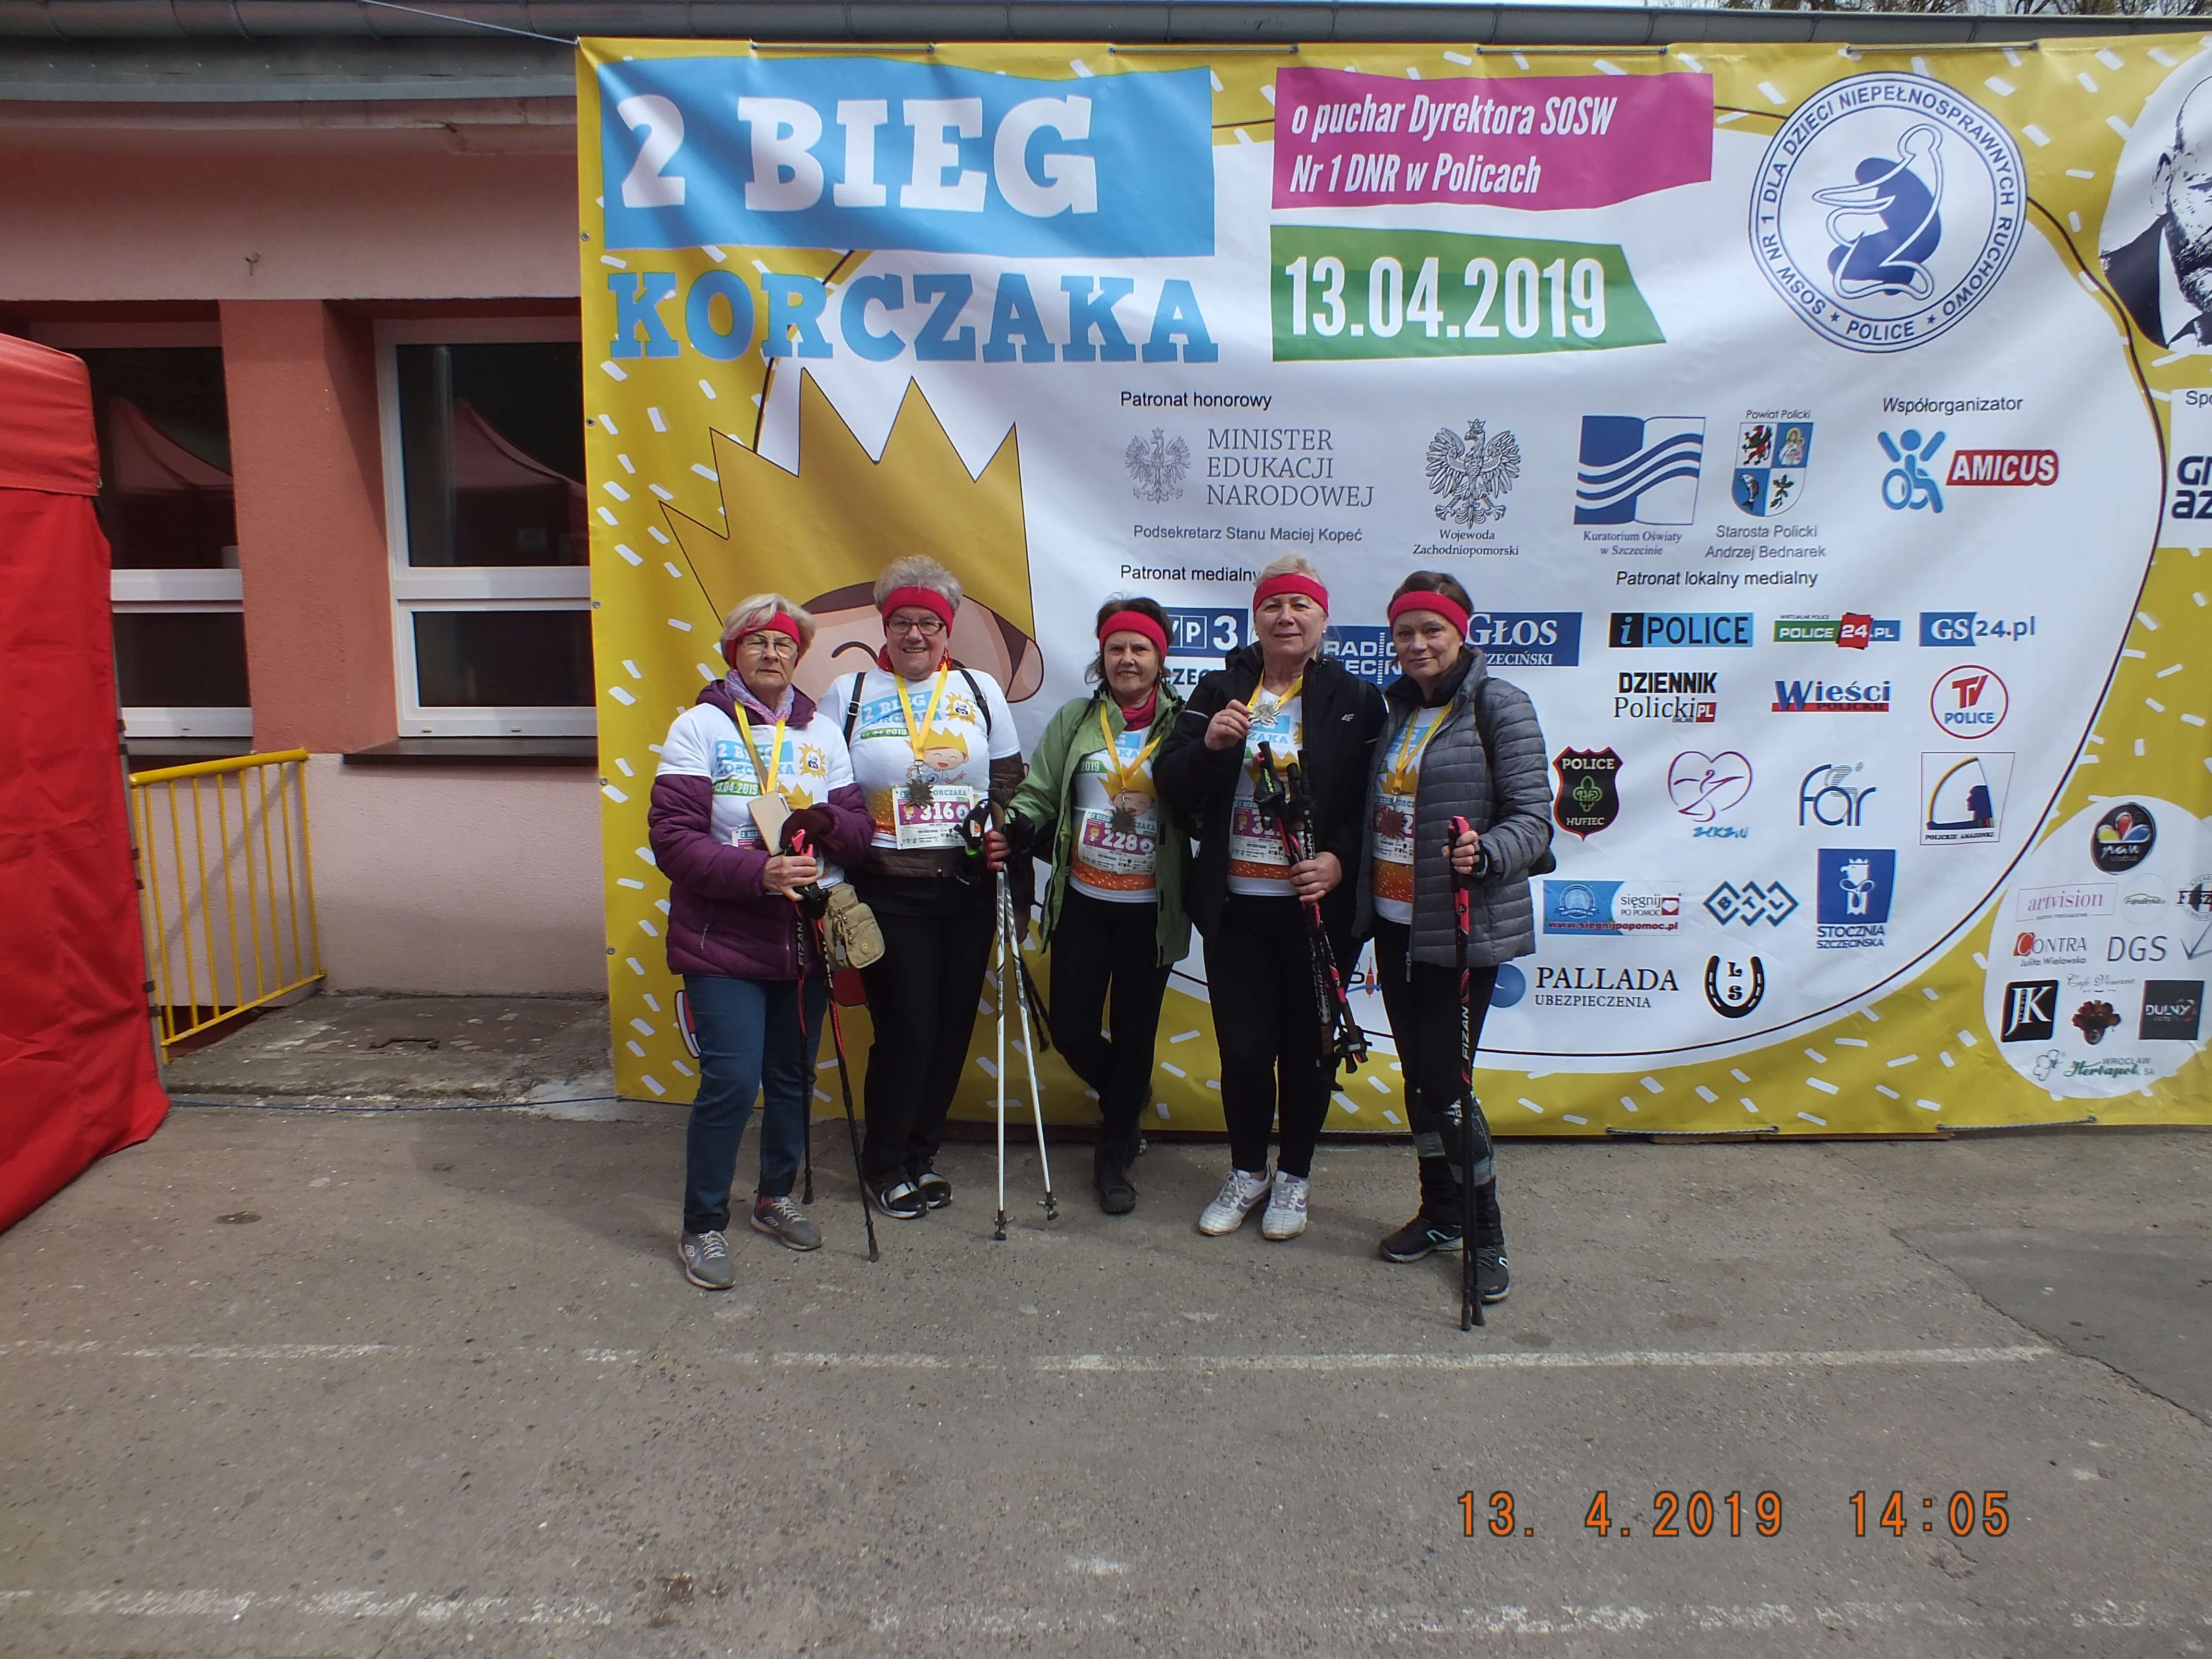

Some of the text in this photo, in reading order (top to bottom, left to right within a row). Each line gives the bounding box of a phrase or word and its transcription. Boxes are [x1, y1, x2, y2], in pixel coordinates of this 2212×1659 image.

[1291, 94, 1618, 142] o puchar Dyrektora SOSW
[618, 95, 1097, 218] 2 BIEG
[1290, 153, 1541, 193] Nr 1 DNR w Policach
[1762, 85, 2015, 316] SOSW NR 1 DLA DZIECI NIEPEŁNOSPRAWNYCH RUCHOWO
[1286, 256, 1606, 339] 13.04.2019
[609, 270, 1219, 363] KORCZAKA
[1846, 321, 1915, 341] POLICE
[1121, 392, 1272, 410] Patronat honorowy
[1883, 397, 2023, 415] Współorganizator
[1746, 410, 1811, 419] Powiat Policki
[1208, 429, 1333, 450] MINISTER
[1207, 457, 1334, 479] EDUKACJI
[1953, 456, 2055, 481] AMICUS
[1207, 485, 1374, 507] NARODOWEJ
[1134, 526, 1362, 543] Podsekretarz Stanu Maciej Kopeć
[1440, 530, 1494, 542] Wojewoda
[1584, 531, 1682, 543] Kuratorium Oświaty
[1716, 525, 1817, 538] Starosta Policki
[1413, 545, 1518, 557] Zachodniopomorski
[1611, 546, 1662, 555] Szczecinie
[1706, 545, 1826, 560] Andrzej Bednarek
[1121, 565, 1186, 580] Patronat
[1617, 571, 1818, 589] Patronat lokalny medialny
[1466, 613, 1558, 647] GŁOS
[1485, 651, 1552, 665] ZECIŃSKI
[1619, 672, 1718, 693] DZIENNIK
[1952, 674, 1988, 709] TV
[1775, 681, 1890, 710] Wieści
[1614, 696, 1695, 718] Policki
[1341, 713, 1355, 722] 4F
[1945, 712, 1994, 724] POLICE
[718, 744, 727, 757] 2
[1562, 758, 1615, 769] POLICE
[1102, 829, 1137, 851] 228
[1621, 894, 1660, 908] sięgnij
[2028, 890, 2104, 911] artvision
[1817, 926, 1885, 937] STOCZNIA
[1816, 938, 1884, 949] SZCZECIŃSKA
[2107, 936, 2167, 962] DGS
[1537, 966, 1679, 991] PALLADA
[1536, 994, 1651, 1008] UBEZPIECZENIA
